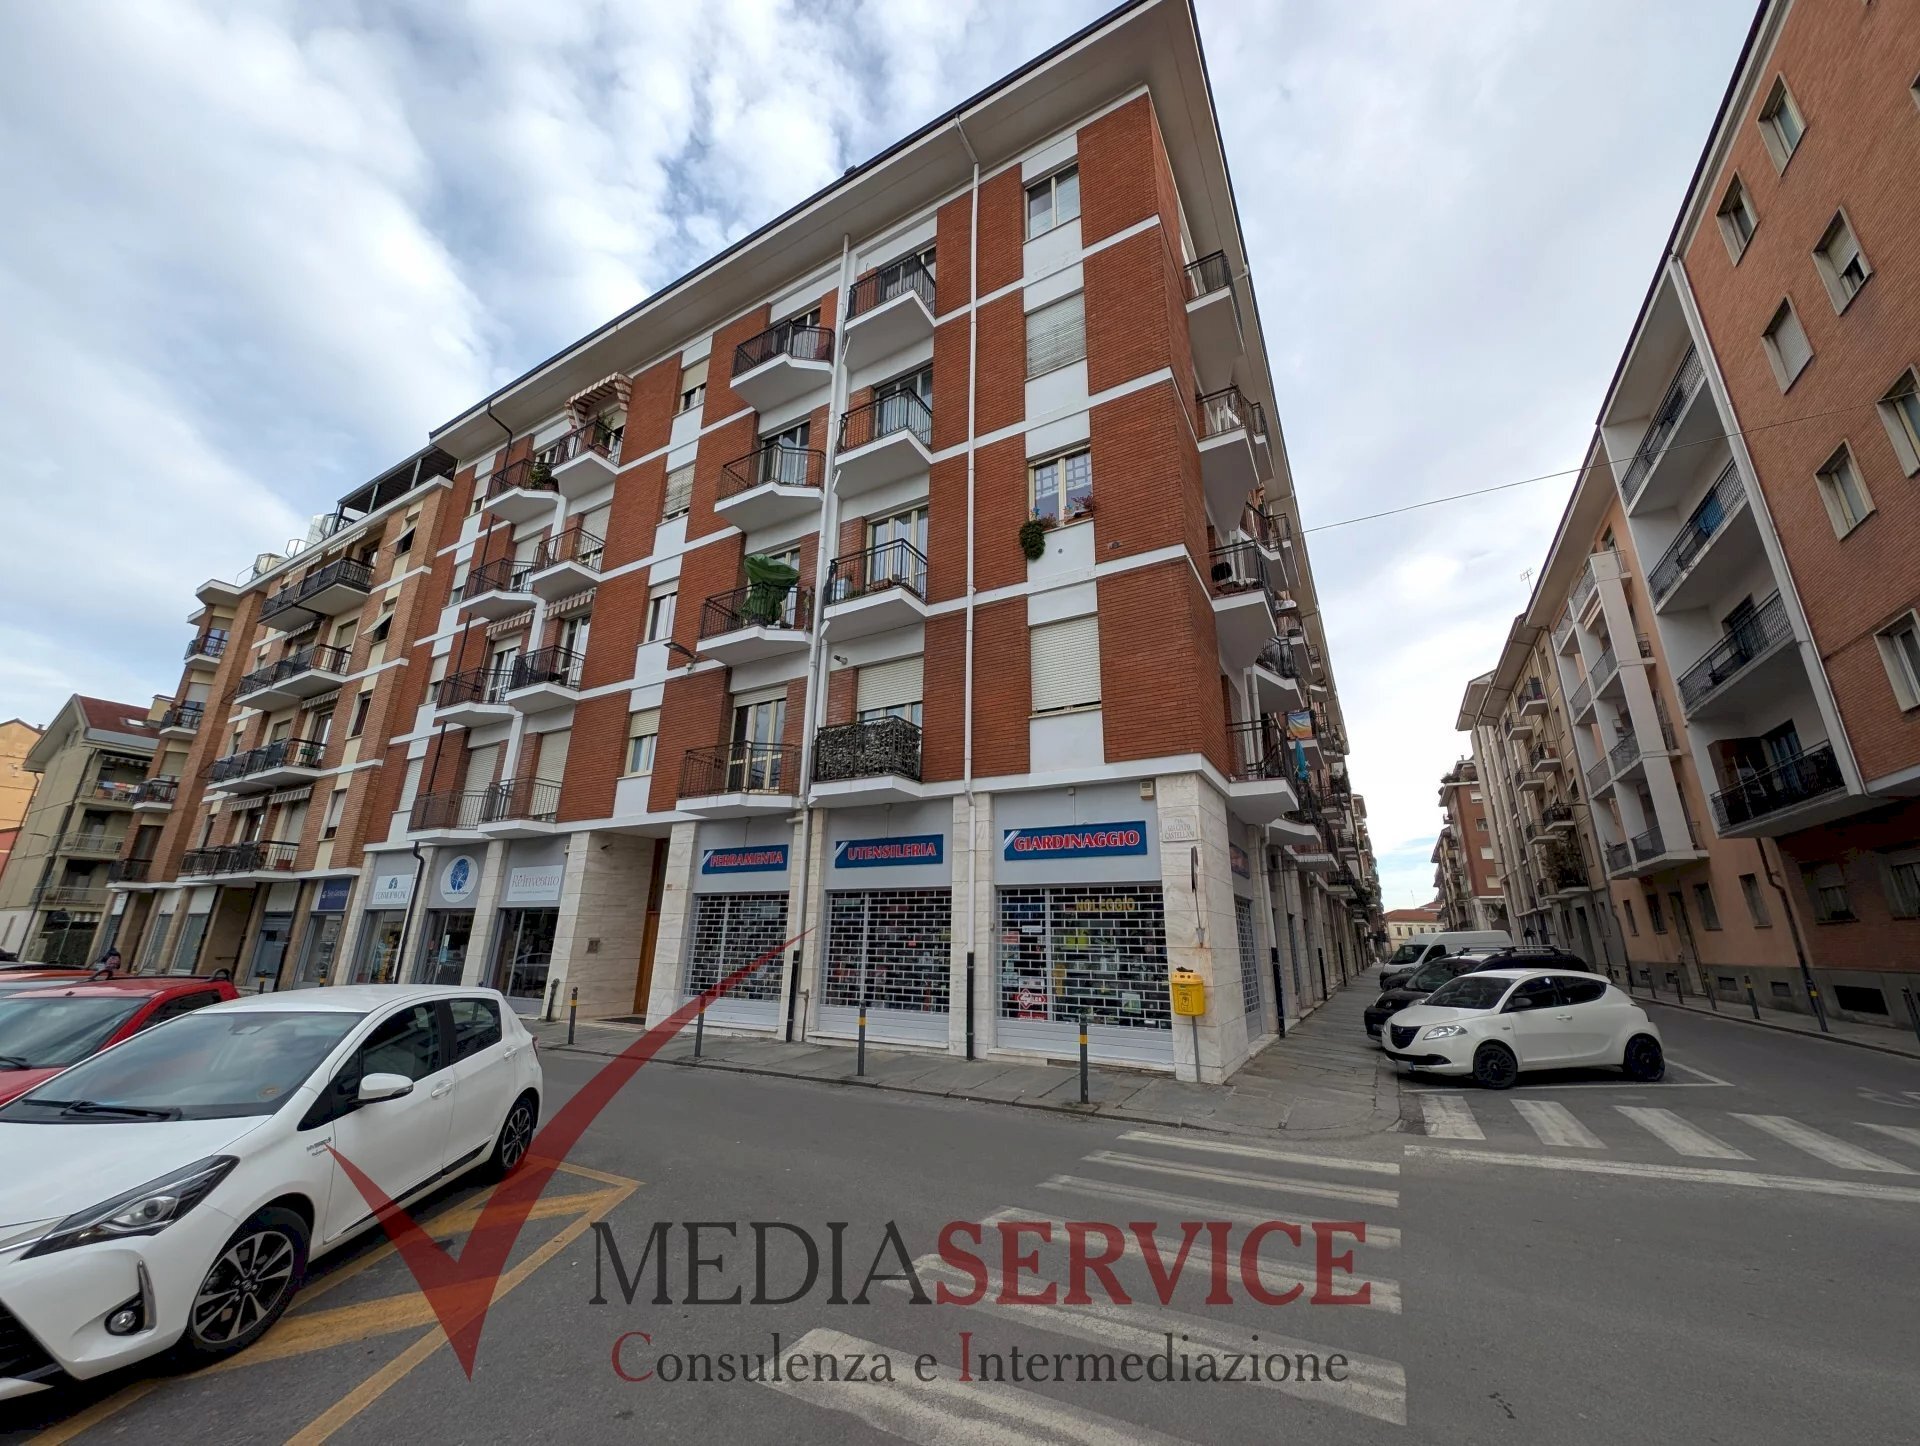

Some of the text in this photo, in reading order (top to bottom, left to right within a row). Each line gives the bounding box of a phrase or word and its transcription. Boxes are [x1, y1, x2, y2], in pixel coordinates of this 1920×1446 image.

[1014, 830, 1140, 851] GIARDINAGGIO
[710, 850, 784, 868] FERRAMENTA
[847, 842, 937, 861] UTENSILERIA
[1076, 897, 1136, 912] NOLEGGIO
